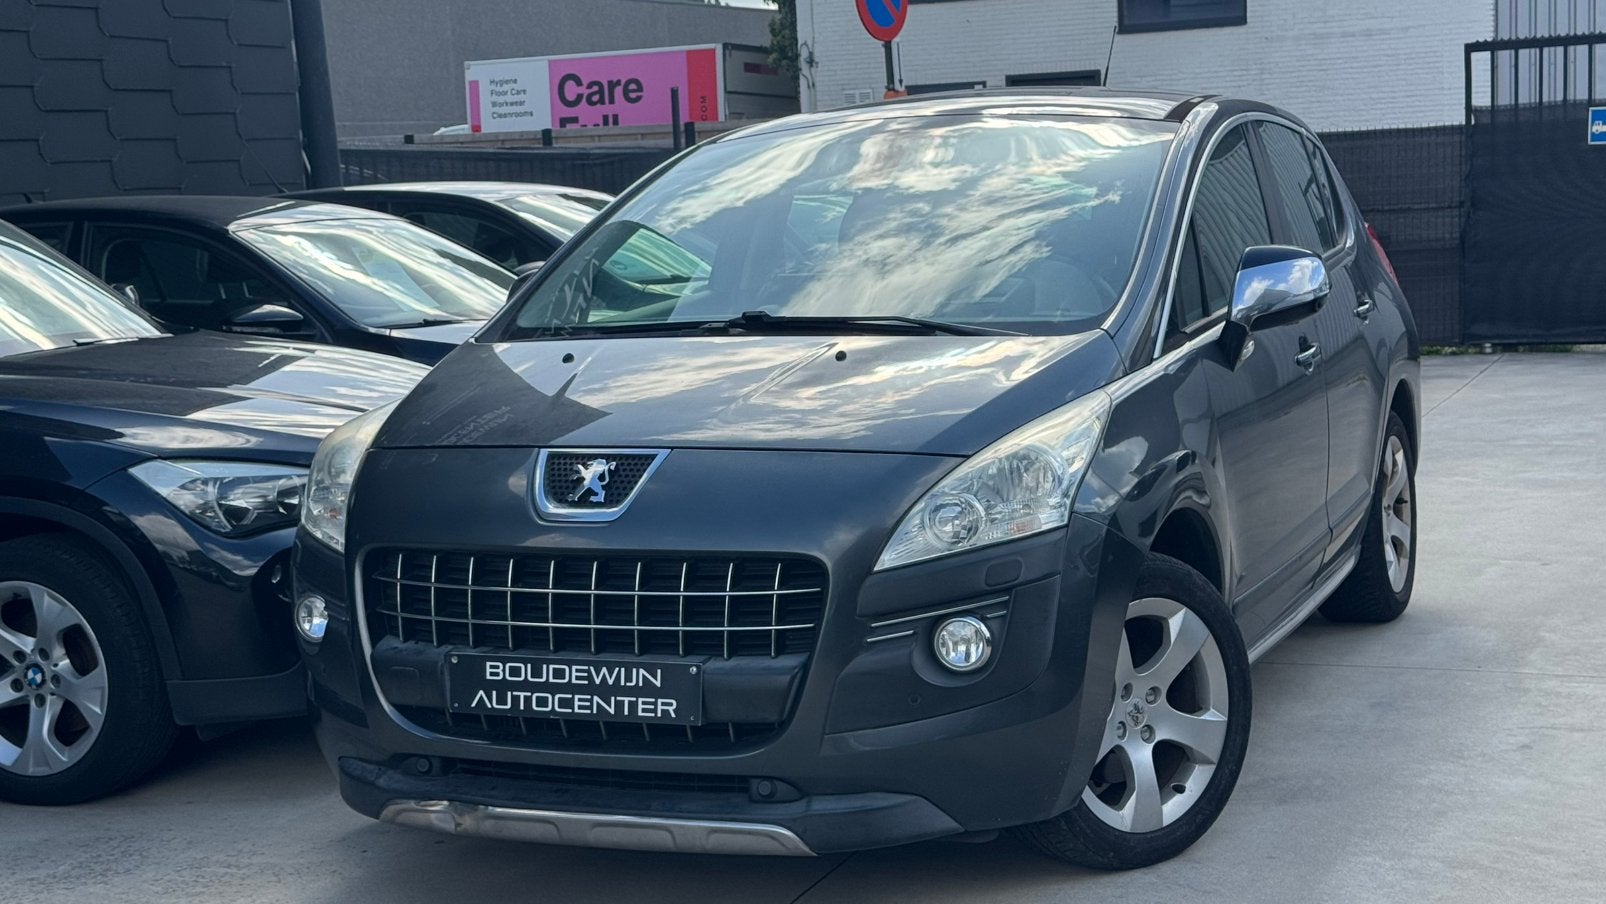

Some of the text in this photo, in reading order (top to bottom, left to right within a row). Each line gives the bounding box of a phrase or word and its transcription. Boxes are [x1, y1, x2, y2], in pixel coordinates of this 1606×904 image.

[489, 78, 518, 88] Hygiene
[490, 88, 527, 97] Floor Care
[558, 73, 644, 108] Care
[491, 100, 526, 108] Workwear
[491, 111, 534, 119] Cleanrooms
[485, 660, 662, 688] BOUDEWIJN
[470, 689, 678, 718] AUTOCENTER
